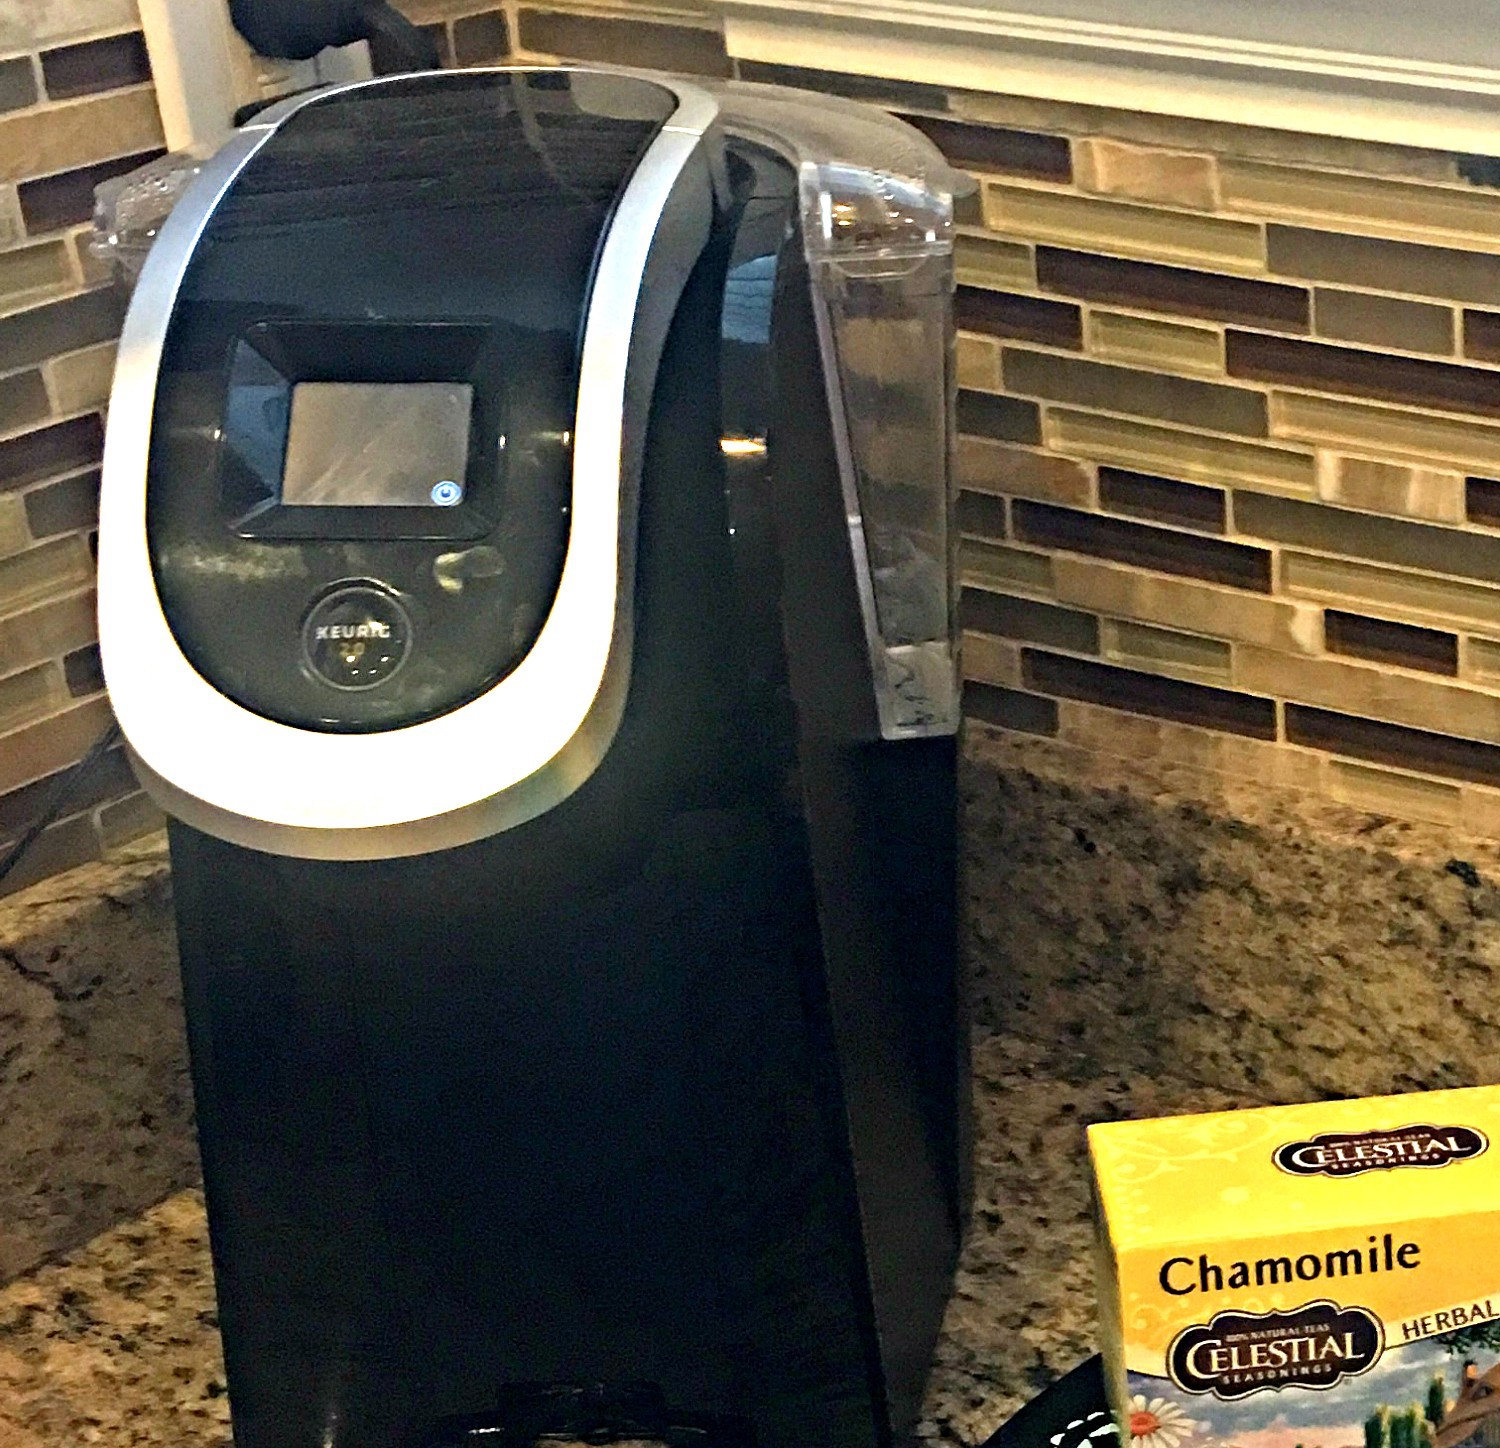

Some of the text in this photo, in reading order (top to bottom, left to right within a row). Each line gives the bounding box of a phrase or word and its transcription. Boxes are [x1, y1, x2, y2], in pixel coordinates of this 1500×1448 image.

[315, 624, 390, 639] KEURIG
[1291, 1136, 1472, 1168] CELESTIAL
[1159, 1234, 1421, 1295] Chamomile
[1401, 1300, 1500, 1340] HERBAL
[1186, 1332, 1365, 1379] CELESTIAL
[1222, 1364, 1332, 1385] SEASONINGS
